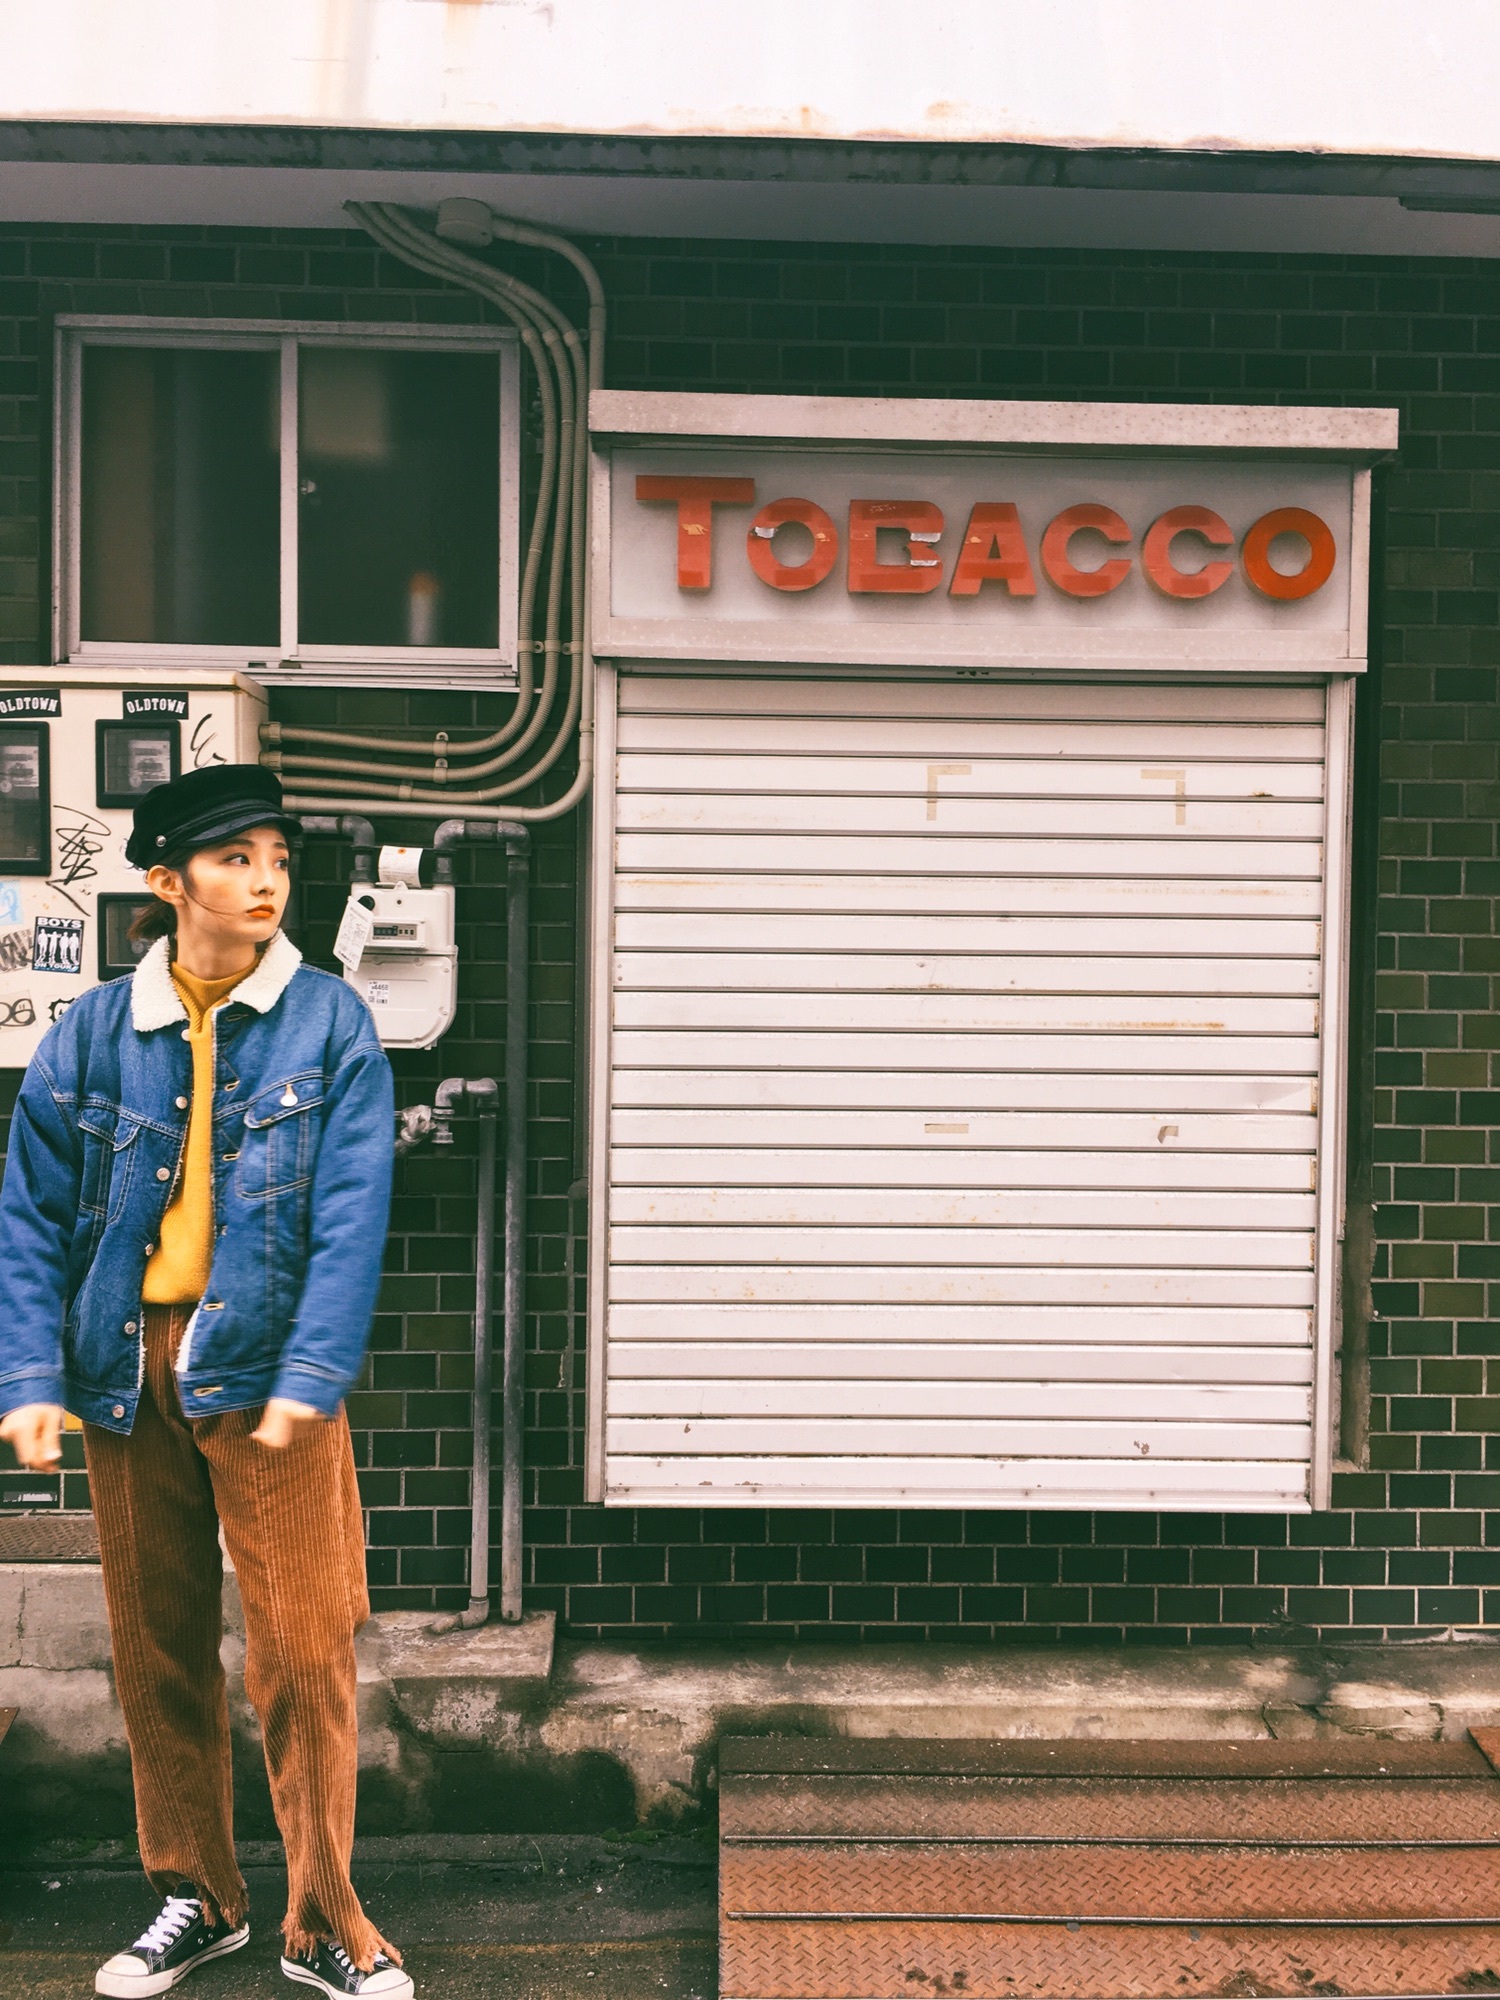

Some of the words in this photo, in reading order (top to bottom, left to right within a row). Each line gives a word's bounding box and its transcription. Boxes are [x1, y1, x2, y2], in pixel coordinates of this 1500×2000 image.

[636, 476, 1336, 599] TOBACCO
[0, 697, 57, 714] OLDTOWN
[126, 698, 186, 714] OLDTOWN
[38, 918, 81, 928] BOYS
